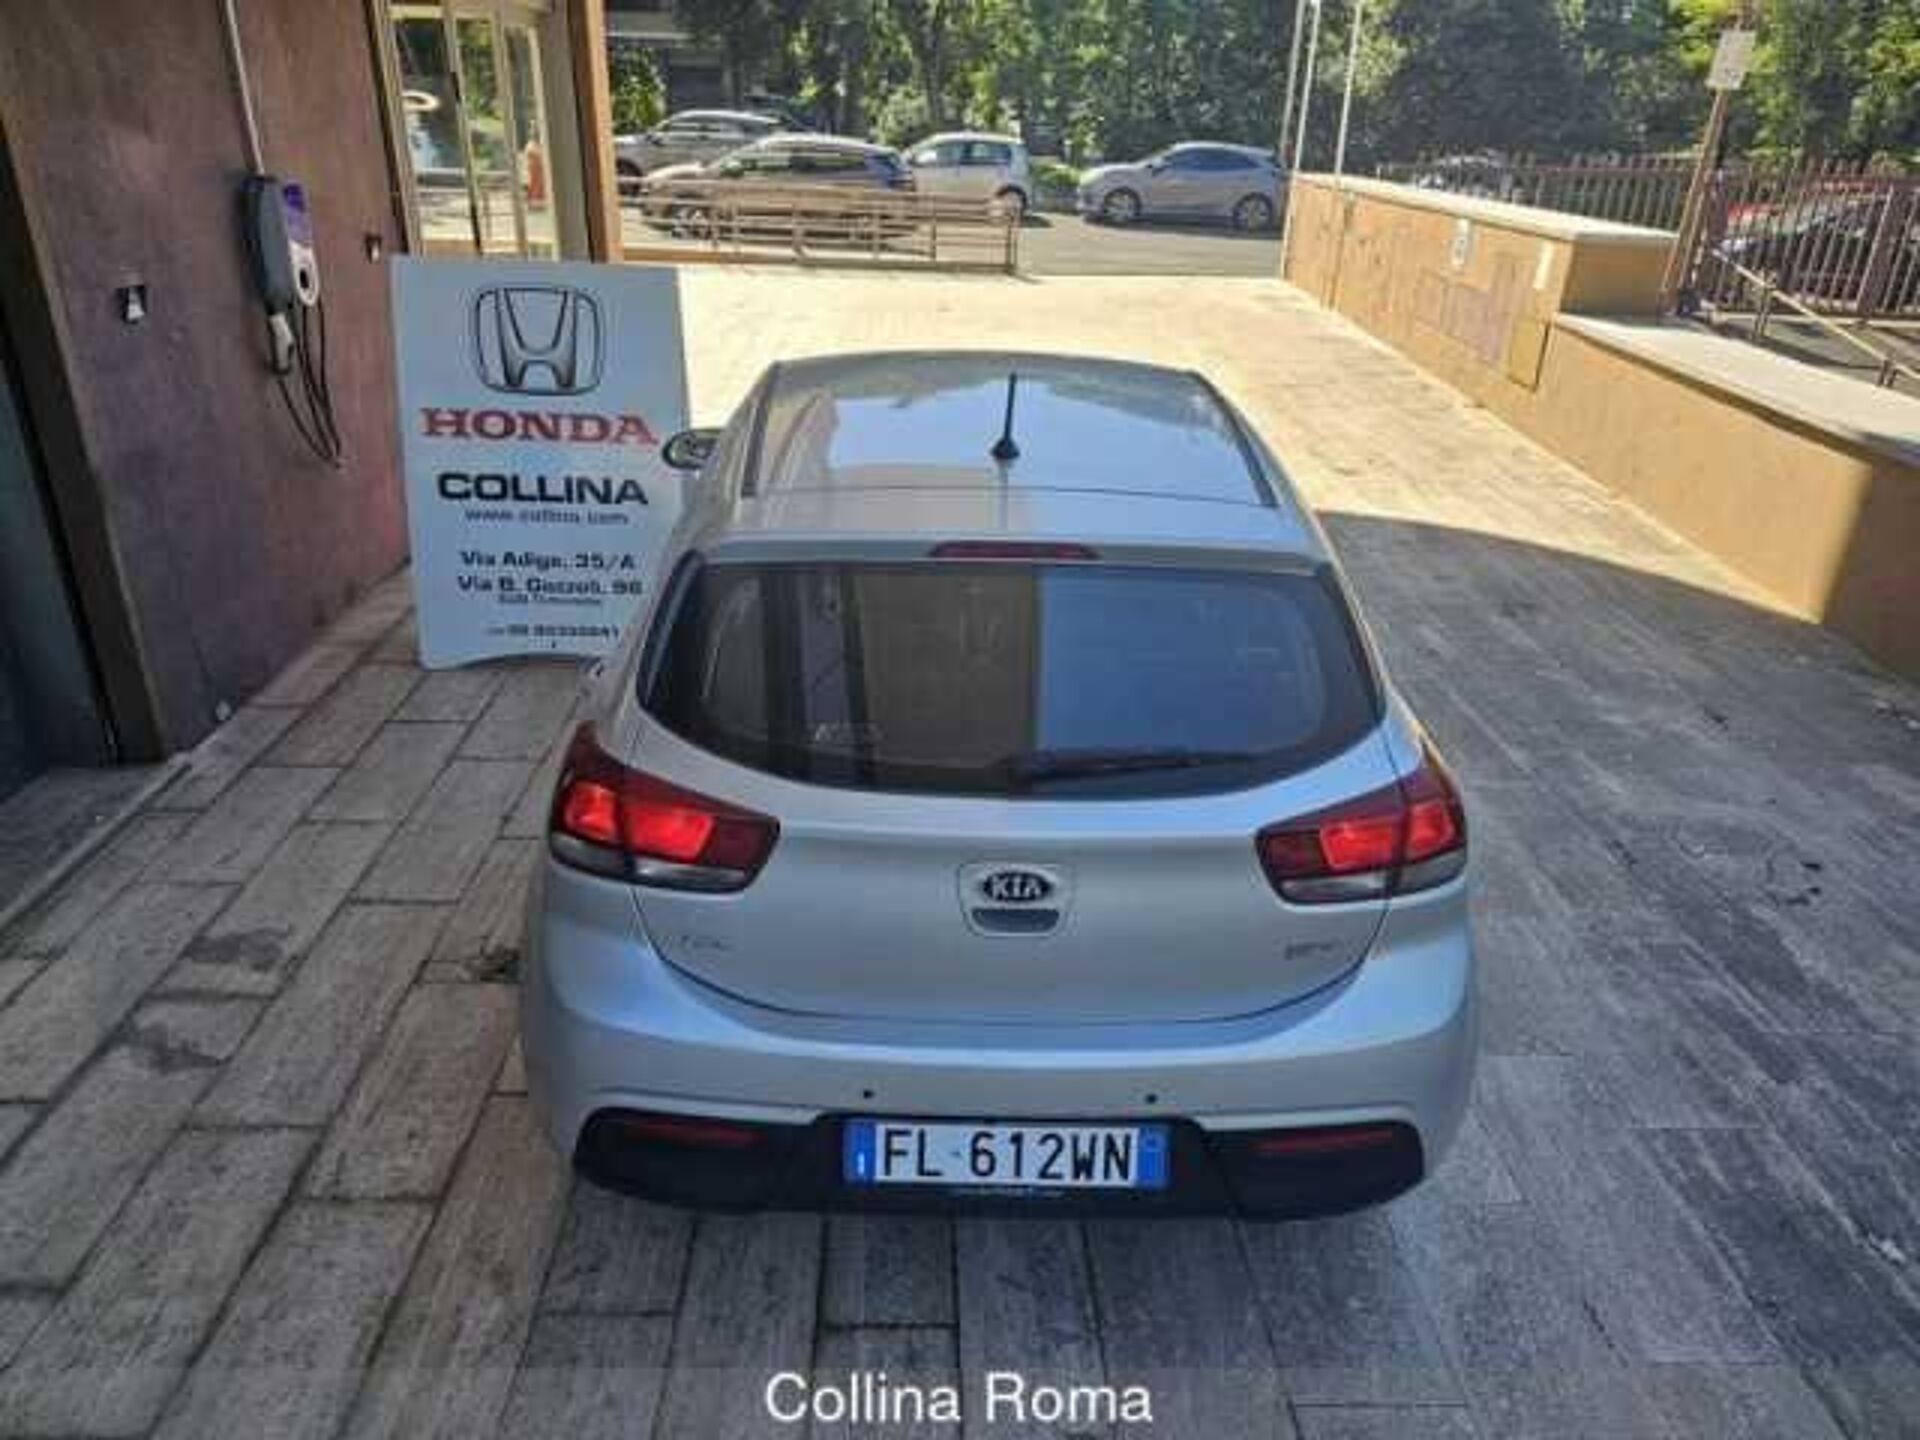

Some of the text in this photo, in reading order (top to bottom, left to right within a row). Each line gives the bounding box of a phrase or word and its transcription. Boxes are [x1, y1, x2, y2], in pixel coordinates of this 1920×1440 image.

[420, 408, 659, 446] HONDA
[438, 473, 648, 505] COLLINA
[460, 551, 495, 566] Via
[458, 575, 492, 591] Via
[992, 876, 1042, 899] KIA
[883, 1128, 1132, 1181] FL 612WN
